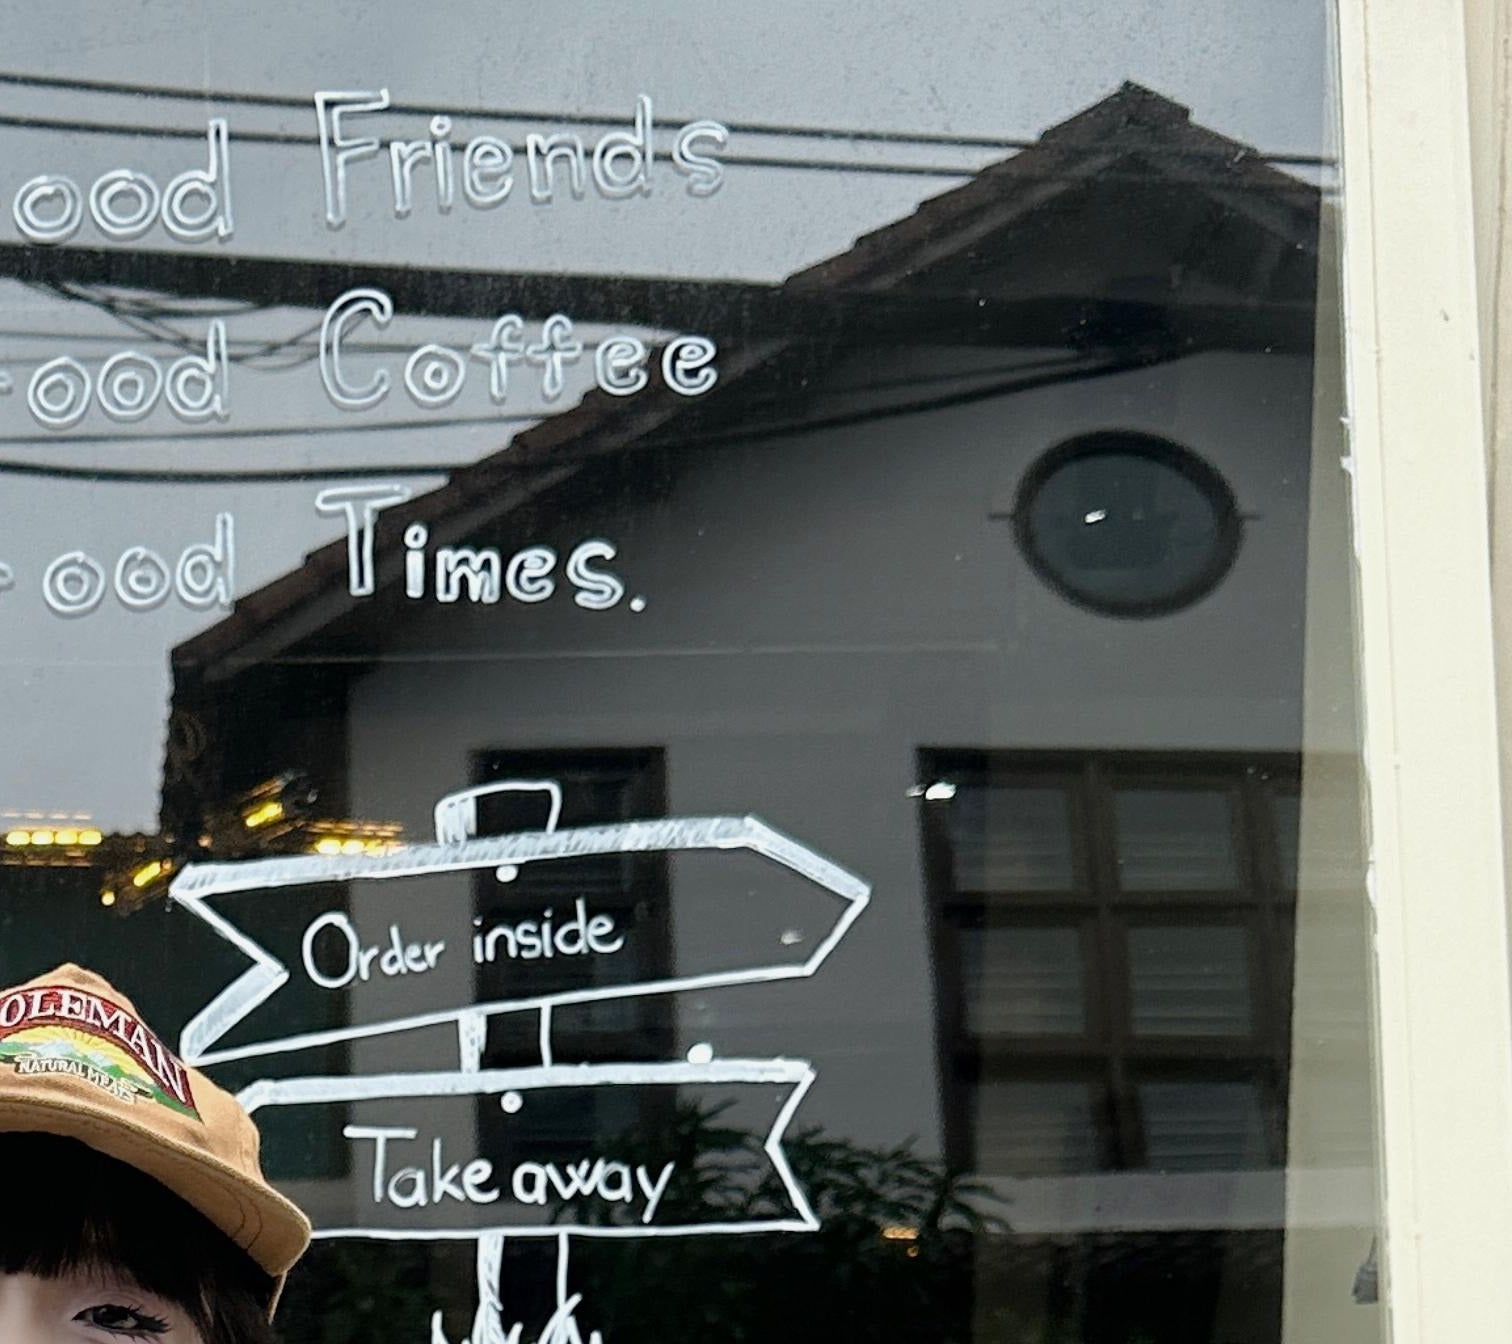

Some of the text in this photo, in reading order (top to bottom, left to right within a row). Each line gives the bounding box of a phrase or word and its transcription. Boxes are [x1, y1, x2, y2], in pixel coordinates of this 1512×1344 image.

[314, 87, 730, 228] Friends
[318, 288, 720, 409] Coffee
[315, 486, 648, 614] Times.
[301, 899, 624, 989] Order inside
[19, 1059, 86, 1077] NATURAL
[344, 1125, 675, 1222] Take away
